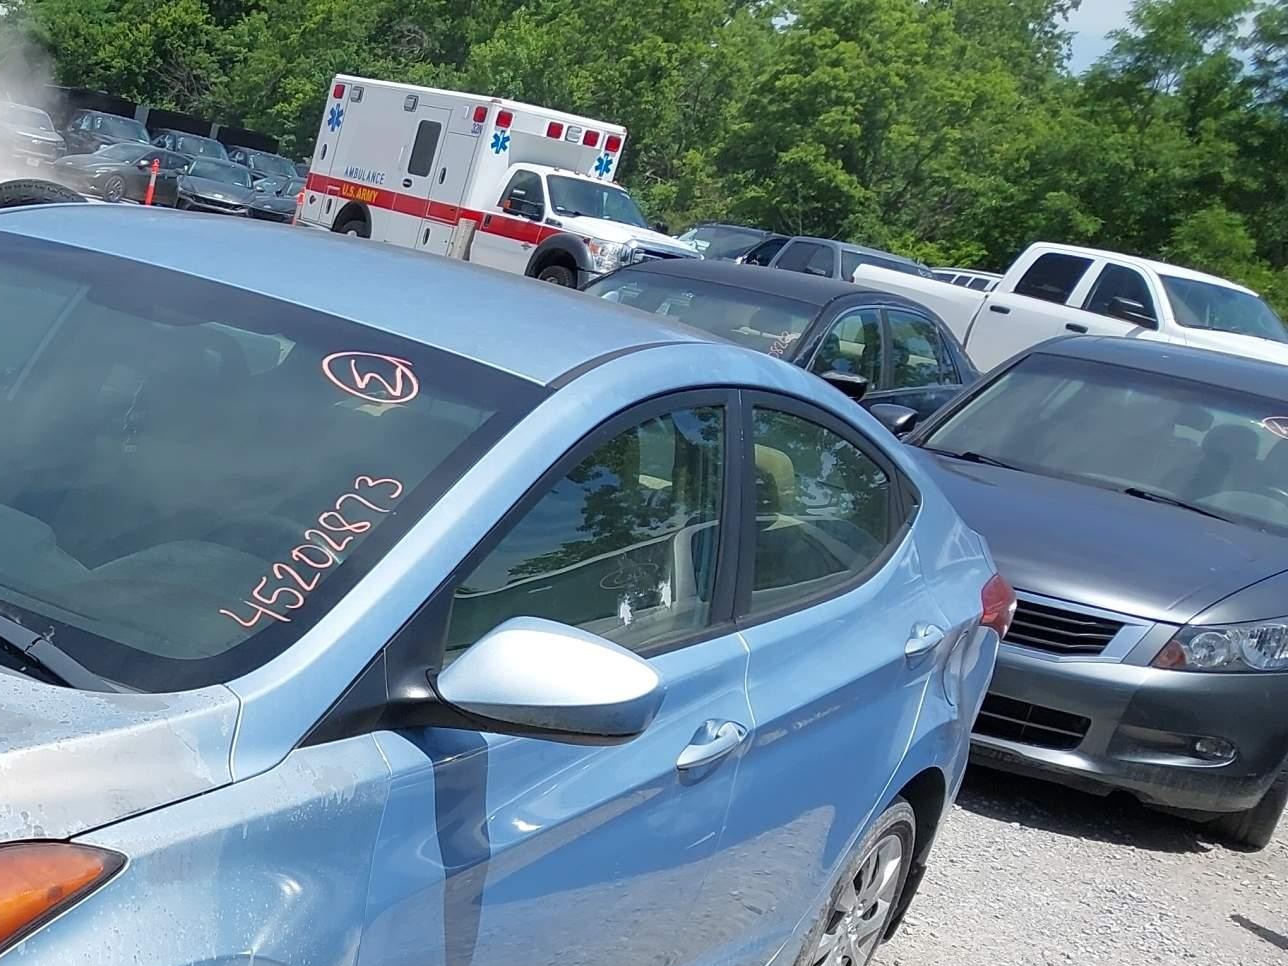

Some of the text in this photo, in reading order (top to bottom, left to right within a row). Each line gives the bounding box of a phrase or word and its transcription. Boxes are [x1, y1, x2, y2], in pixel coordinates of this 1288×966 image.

[344, 166, 385, 185] AMBULANCE
[356, 187, 379, 203] ARMY
[219, 475, 403, 628] 45202873
